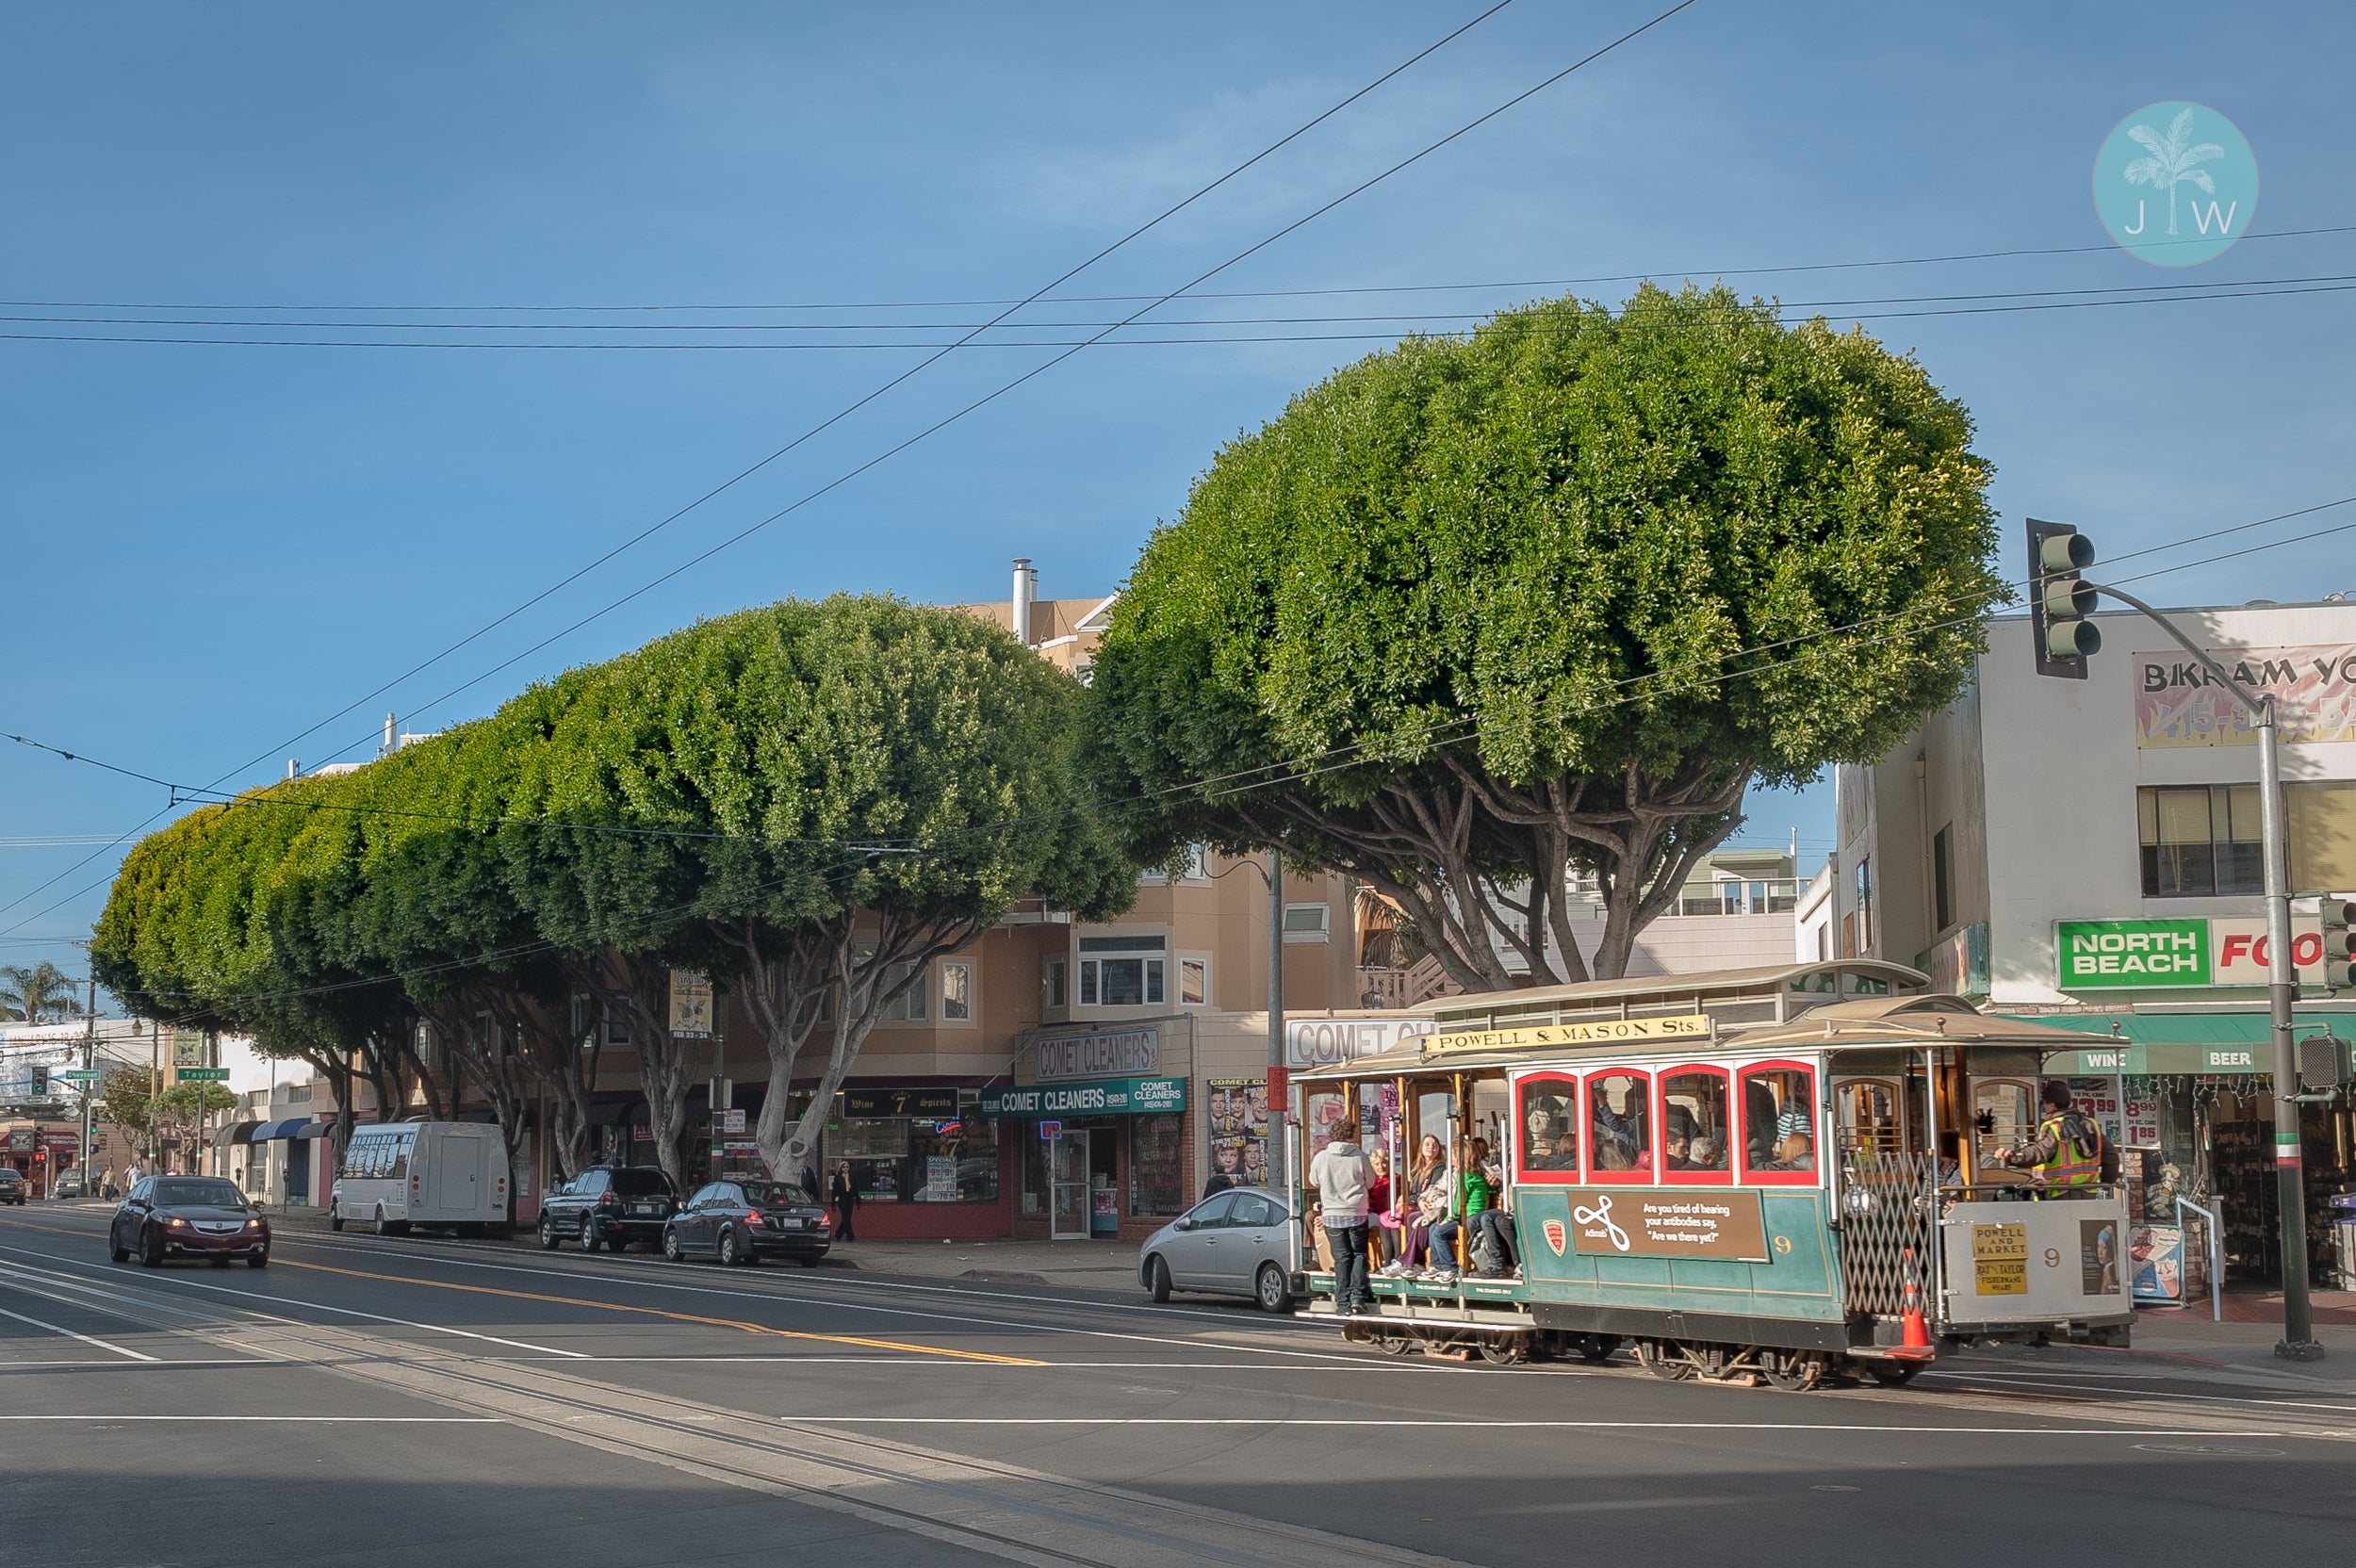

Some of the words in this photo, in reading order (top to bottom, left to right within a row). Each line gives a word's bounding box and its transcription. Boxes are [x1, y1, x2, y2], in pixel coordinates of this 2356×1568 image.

[2144, 658, 2299, 694] BIKRAM
[2072, 931, 2198, 954] NORTH
[2072, 953, 2199, 974] BEACH
[1438, 1032, 1527, 1049] POWELL
[1536, 1029, 1551, 1042] &
[1562, 1021, 1651, 1041] MASON
[1661, 1018, 1700, 1034] Sts.
[1297, 1023, 1388, 1062] COMET
[1039, 1038, 1080, 1075] COMET
[1083, 1032, 1150, 1071] CLEANERS
[2209, 1052, 2251, 1067] BEER
[1140, 1081, 1173, 1091] COMET
[1002, 1092, 1040, 1112] COMET
[1044, 1088, 1104, 1111] CLEANERS
[1134, 1089, 1182, 1101] CLEANERS
[896, 1097, 906, 1113] 7
[1643, 1202, 1657, 1213] Are
[1657, 1205, 1672, 1216] you
[1672, 1203, 1691, 1214] tired
[1692, 1202, 1700, 1214] of
[1700, 1203, 1730, 1217] hearing
[1644, 1217, 1661, 1228] your
[1662, 1216, 1701, 1227] antibodies
[1677, 1231, 1698, 1242] there
[1976, 1228, 2024, 1238] POWELL
[1774, 1235, 1792, 1254] 9
[1977, 1244, 2026, 1254] MARKET
[2044, 1248, 2061, 1268] 9
